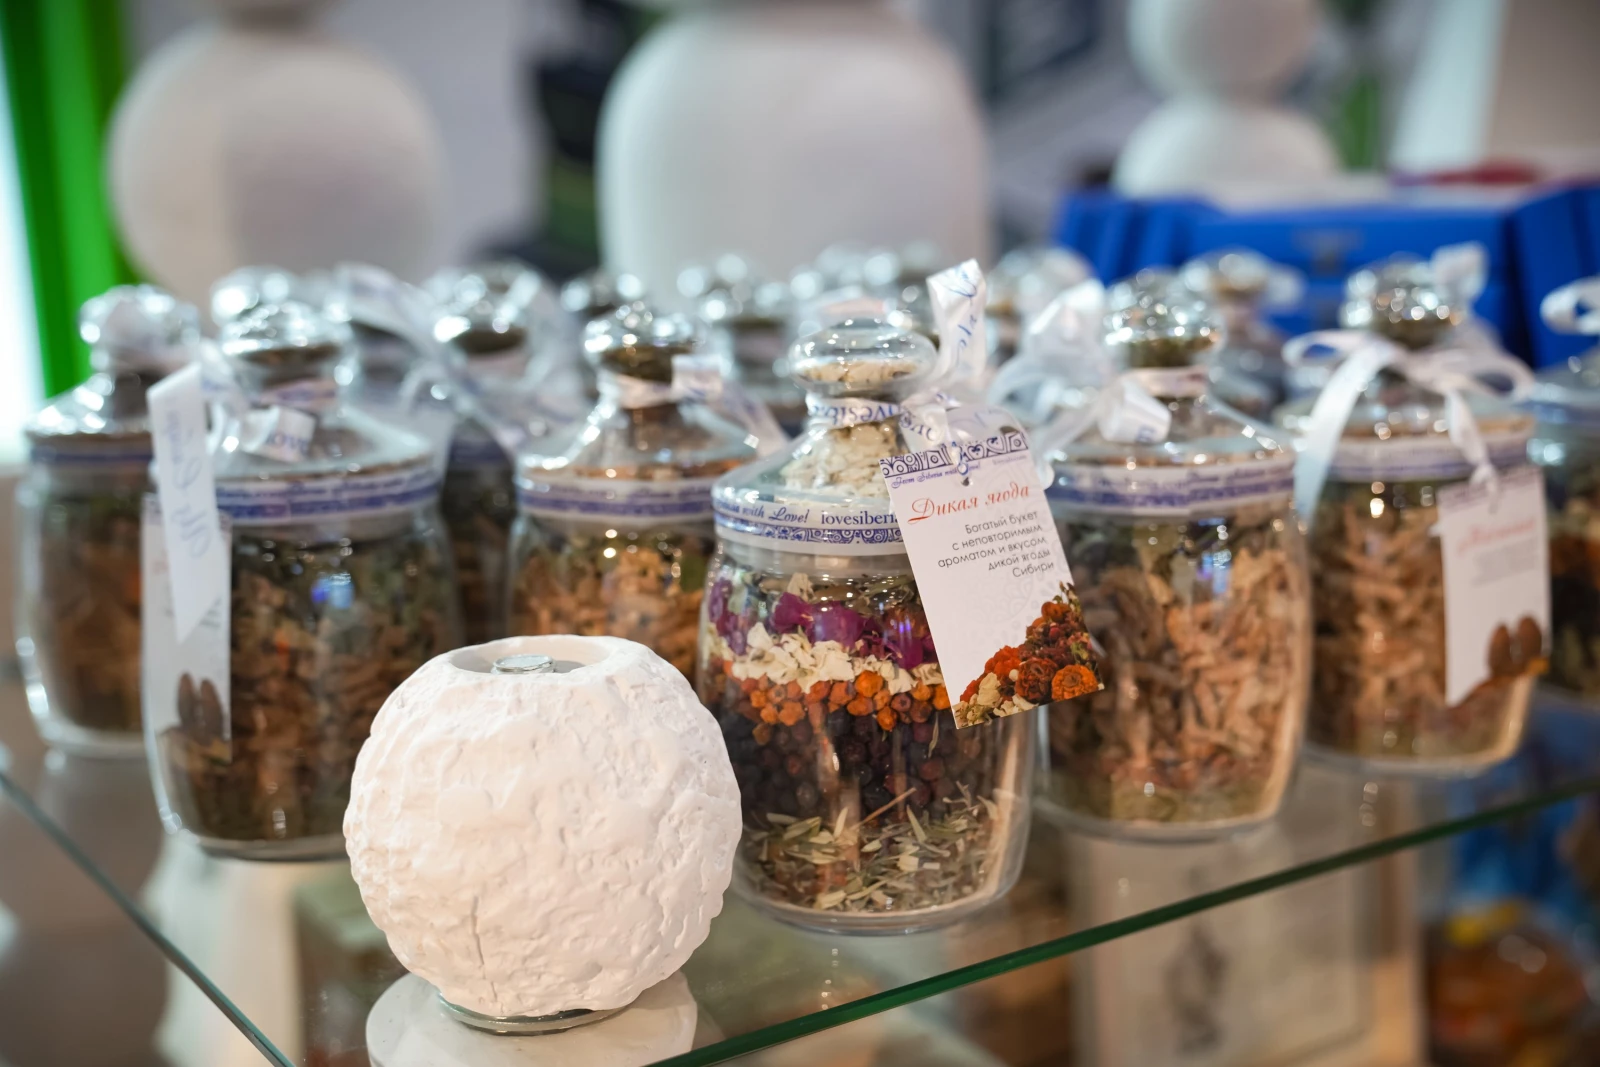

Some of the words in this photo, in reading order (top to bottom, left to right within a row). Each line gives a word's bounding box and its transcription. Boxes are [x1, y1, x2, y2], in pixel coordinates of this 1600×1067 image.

[891, 476, 915, 489] From
[742, 505, 765, 519] with
[768, 507, 810, 523] Love!
[907, 496, 979, 525] Дикая
[985, 481, 1029, 506] ягода
[964, 516, 1008, 535] Богатый
[1008, 511, 1038, 526] букет
[952, 542, 960, 551] с
[961, 524, 1043, 549] неповторимым
[937, 548, 997, 568] ароматом
[998, 545, 1006, 554] и
[1007, 536, 1048, 552] вкусом
[988, 553, 1020, 571] дикой
[1022, 548, 1051, 563] ягоды
[1012, 562, 1055, 578] Сибири
